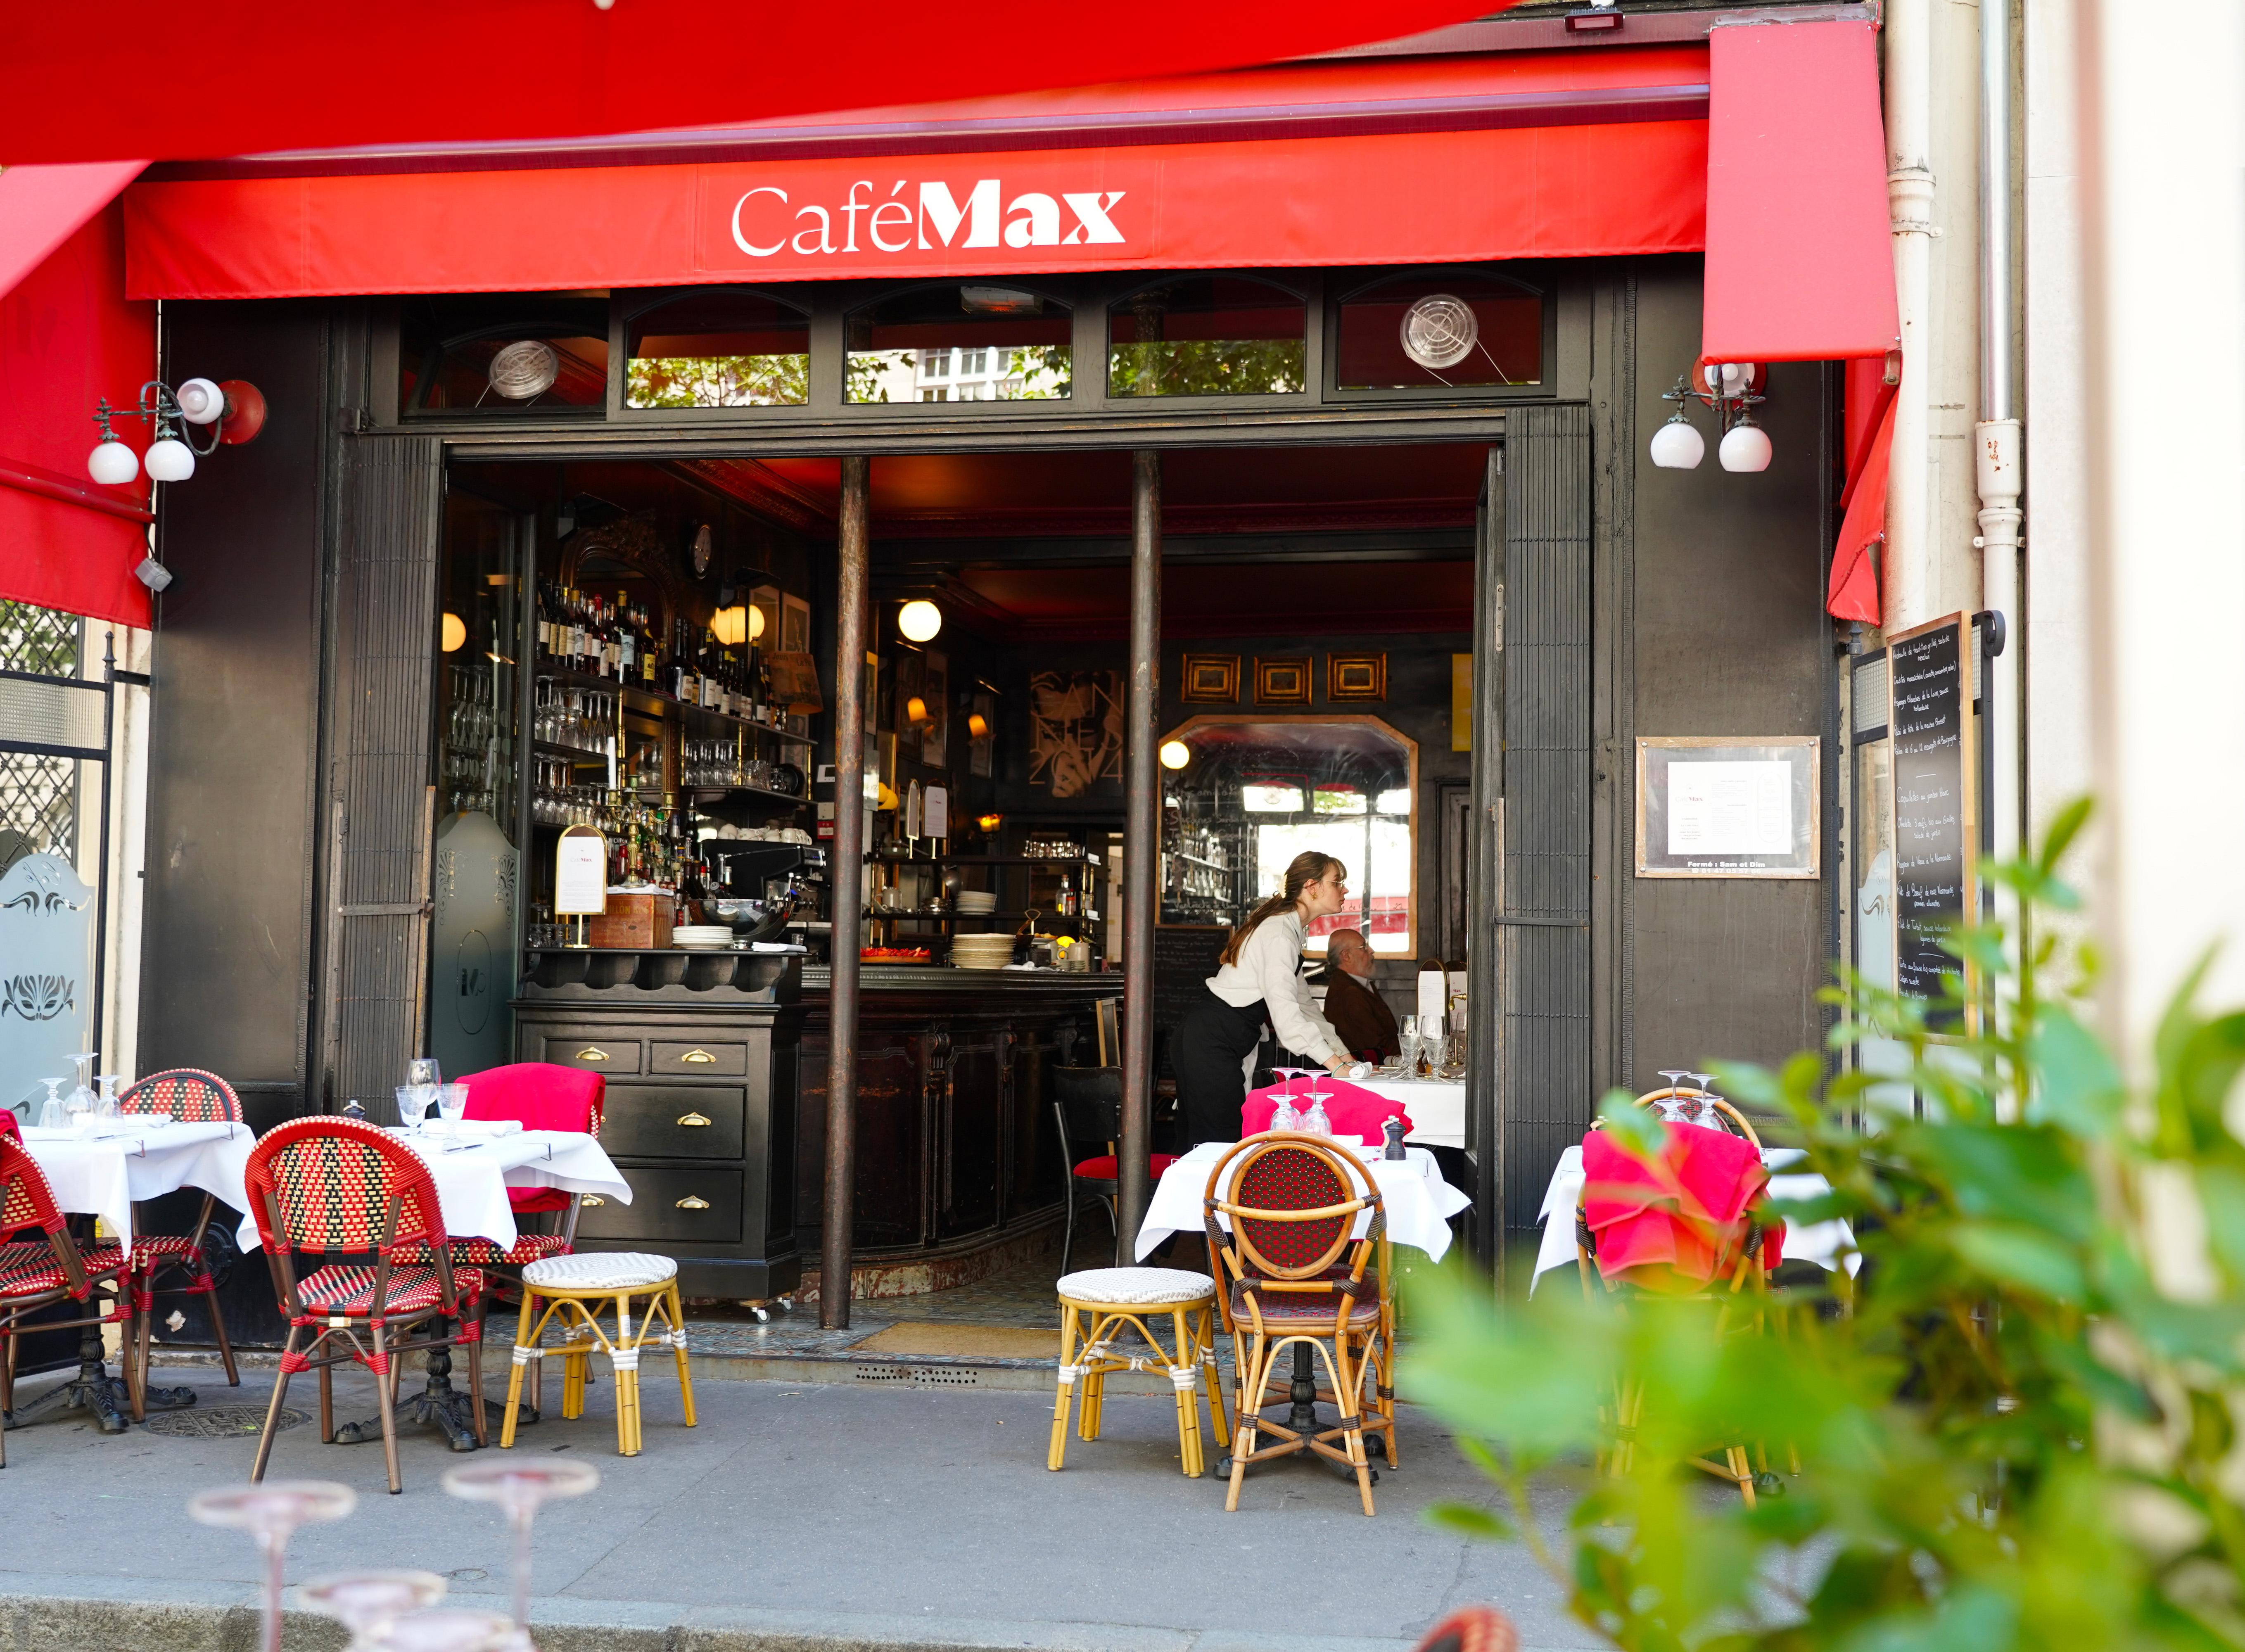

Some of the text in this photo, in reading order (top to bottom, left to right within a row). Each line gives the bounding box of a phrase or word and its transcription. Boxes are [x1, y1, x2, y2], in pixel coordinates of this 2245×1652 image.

[732, 179, 1127, 257] CaféMax
[1908, 645, 1912, 655] de
[1922, 691, 1925, 700] de
[1927, 689, 1930, 698] la
[1903, 725, 1906, 734] de
[1915, 722, 1919, 731] de
[1920, 721, 1923, 729] la
[1905, 744, 1908, 753] de
[1910, 744, 1913, 753] 6
[1937, 736, 1941, 745] de
[1939, 787, 1949, 796] blanc
[1911, 856, 1915, 866] de
[1930, 854, 1934, 863] la
[1906, 884, 1910, 897] de
[1925, 885, 1929, 896] de
[1907, 919, 1910, 929] de
[1942, 965, 1946, 974] de
